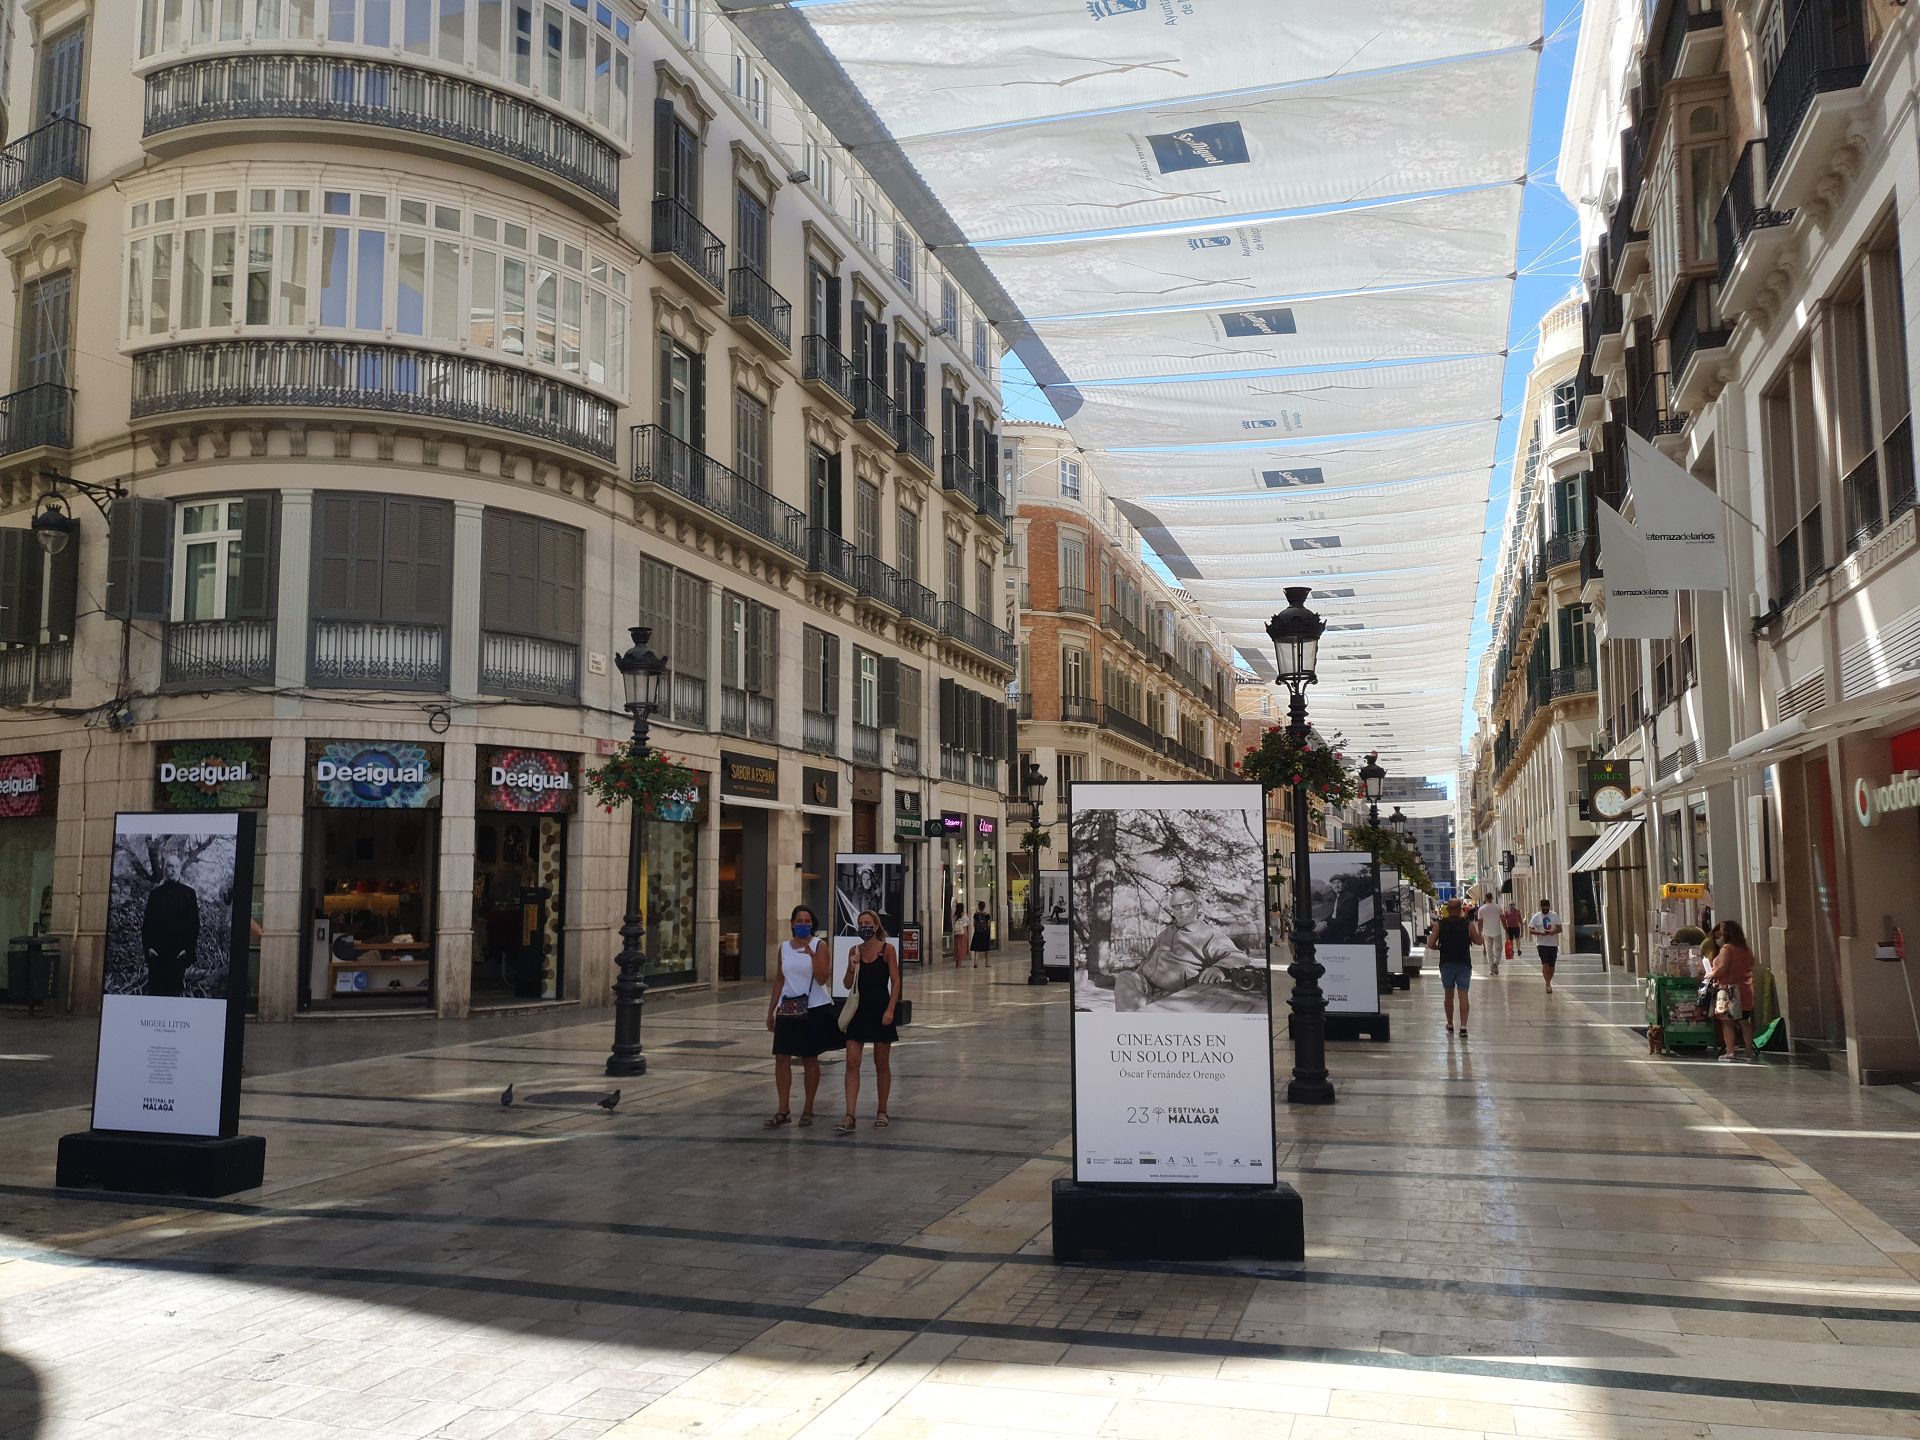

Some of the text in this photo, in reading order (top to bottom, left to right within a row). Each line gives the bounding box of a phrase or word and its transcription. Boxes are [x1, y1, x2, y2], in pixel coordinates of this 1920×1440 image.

[160, 761, 247, 786] Desigual
[317, 761, 424, 786] Desigual
[491, 766, 568, 791] Desigual
[1873, 769, 1920, 813] vodafo
[140, 1019, 166, 1028] MIGUEL
[1116, 1033, 1226, 1047] CINEASTAS EN
[1110, 1050, 1234, 1064] UN SOLO PLANO
[1119, 1066, 1226, 1082] Óscar Fernández Orengo
[1127, 1106, 1150, 1124] 23
